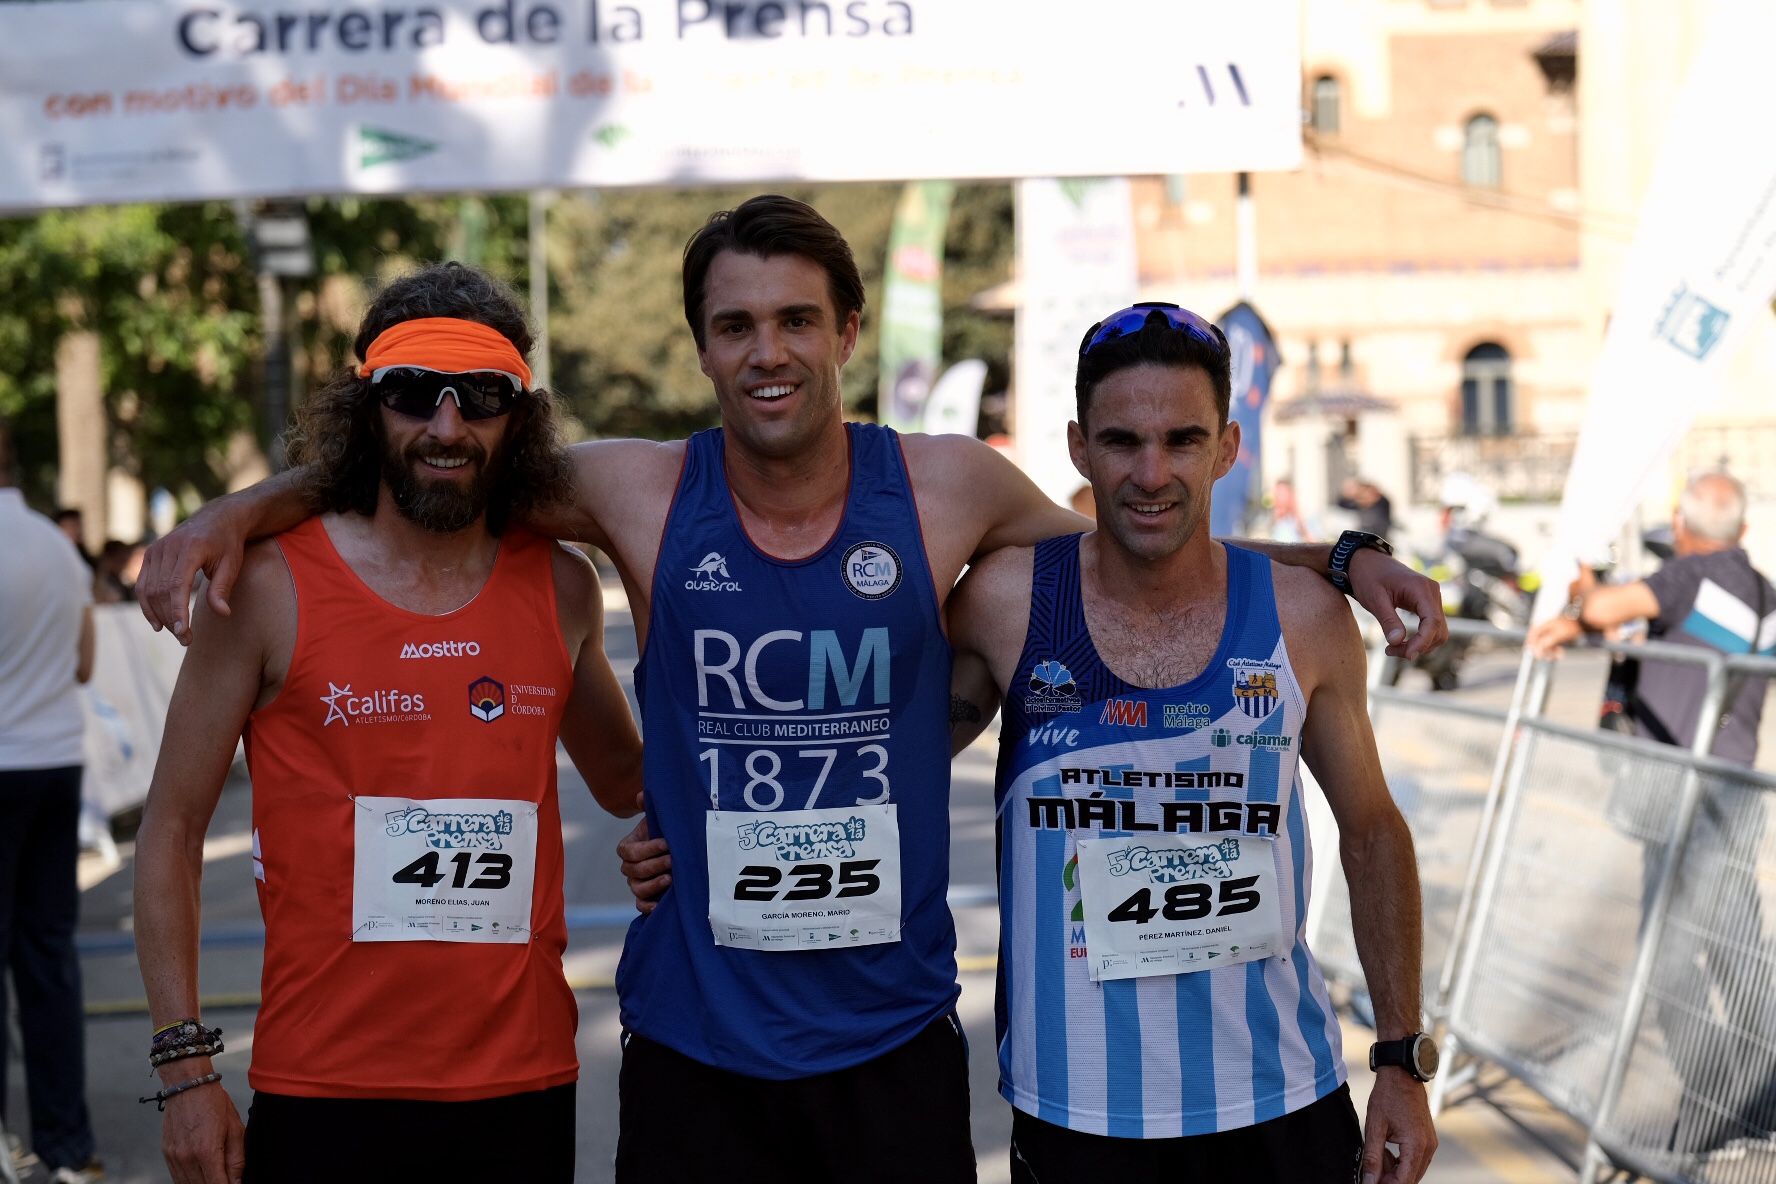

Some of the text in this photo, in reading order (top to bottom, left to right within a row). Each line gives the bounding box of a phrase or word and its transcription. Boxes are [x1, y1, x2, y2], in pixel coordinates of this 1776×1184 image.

[177, 0, 914, 57] Carrera de la Prensa
[43, 92, 113, 119] con
[123, 83, 259, 113] motivo
[853, 562, 891, 578] RCM
[856, 579, 890, 588] MÁLAGA
[400, 641, 481, 659] Mosttro
[693, 627, 892, 711] RCM
[510, 684, 556, 696] UNIVERSIDAD
[347, 689, 425, 715] califas
[511, 703, 546, 715] CÓRDOBA
[1163, 702, 1210, 714] metro
[698, 717, 890, 737] REAL CLUB MEDITERRANEO
[1163, 715, 1210, 729] Málaga
[1236, 731, 1293, 748] cajamar
[699, 743, 890, 812] 1873
[1059, 768, 1244, 788] ATLETISMO
[407, 808, 497, 833] Carrera
[496, 811, 513, 822] de
[1025, 792, 1281, 834] MÁLAGA
[425, 831, 502, 850] Prensa
[757, 821, 847, 847] Carrera
[847, 816, 863, 828] de
[775, 840, 856, 861] Prensa
[1129, 844, 1222, 871] Carrera
[1221, 838, 1238, 850] de
[392, 851, 513, 889] 413
[733, 859, 882, 901] 235
[1148, 860, 1233, 883] Prensa
[1107, 874, 1261, 924] 485
[761, 911, 790, 920] GARCÍA
[827, 909, 851, 917] MARIO
[1205, 925, 1233, 935] DANIEL
